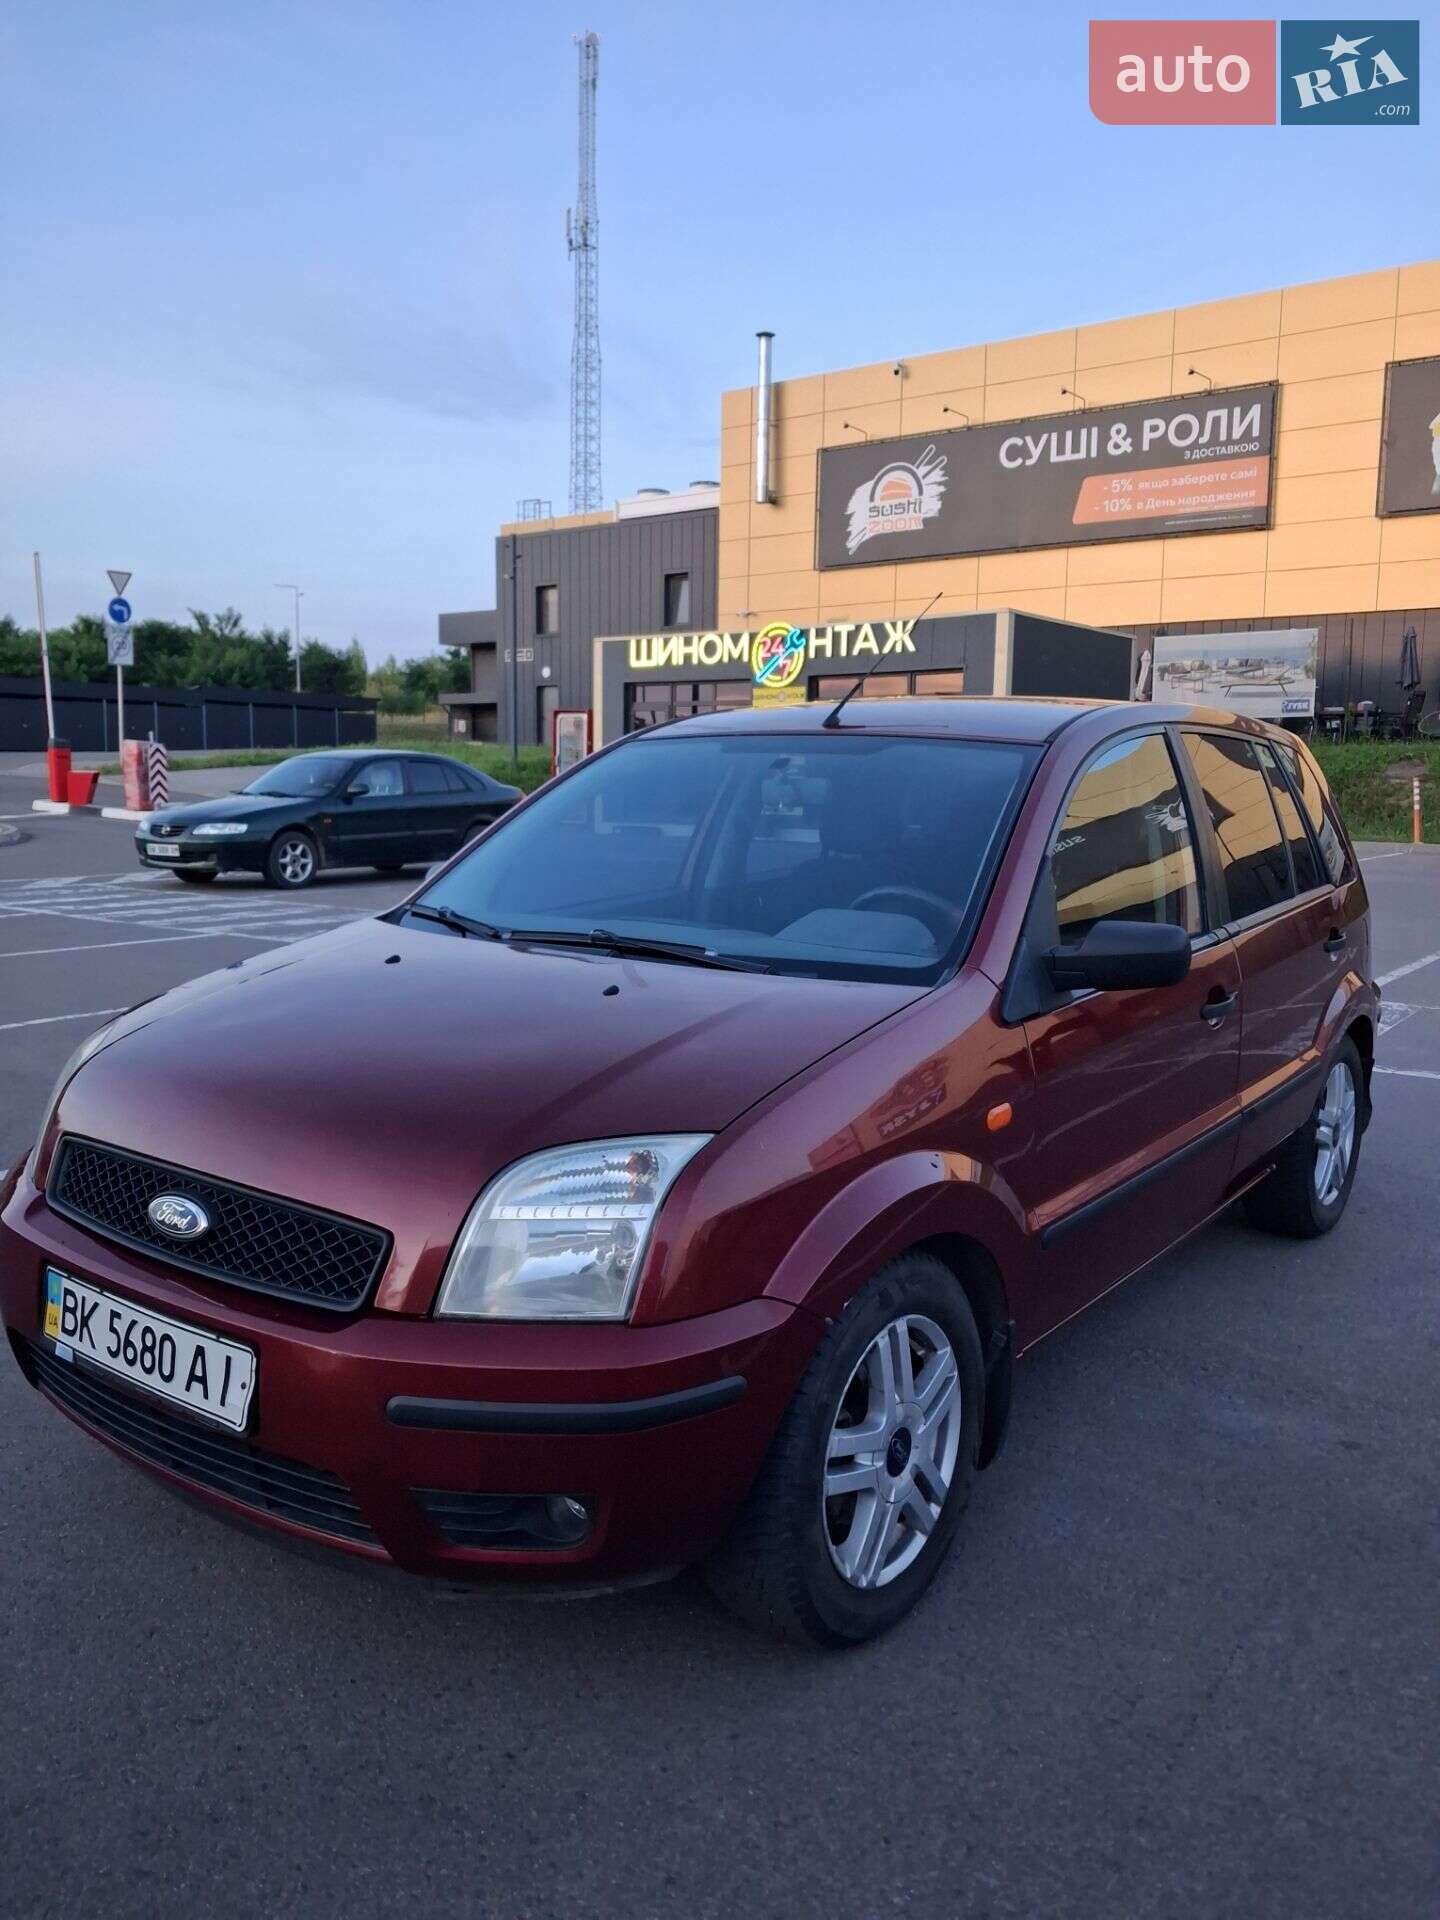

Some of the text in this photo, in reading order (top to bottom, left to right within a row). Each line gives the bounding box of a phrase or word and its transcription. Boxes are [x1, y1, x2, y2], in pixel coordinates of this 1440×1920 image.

[1000, 404, 1261, 469] СУШІ & РОЛИ
[1192, 442, 1259, 459] ДОСТАВКОЮ
[156, 1201, 193, 1229] Ford
[48, 1313, 59, 1328] UA
[61, 1287, 231, 1407] BK 5680 AI
